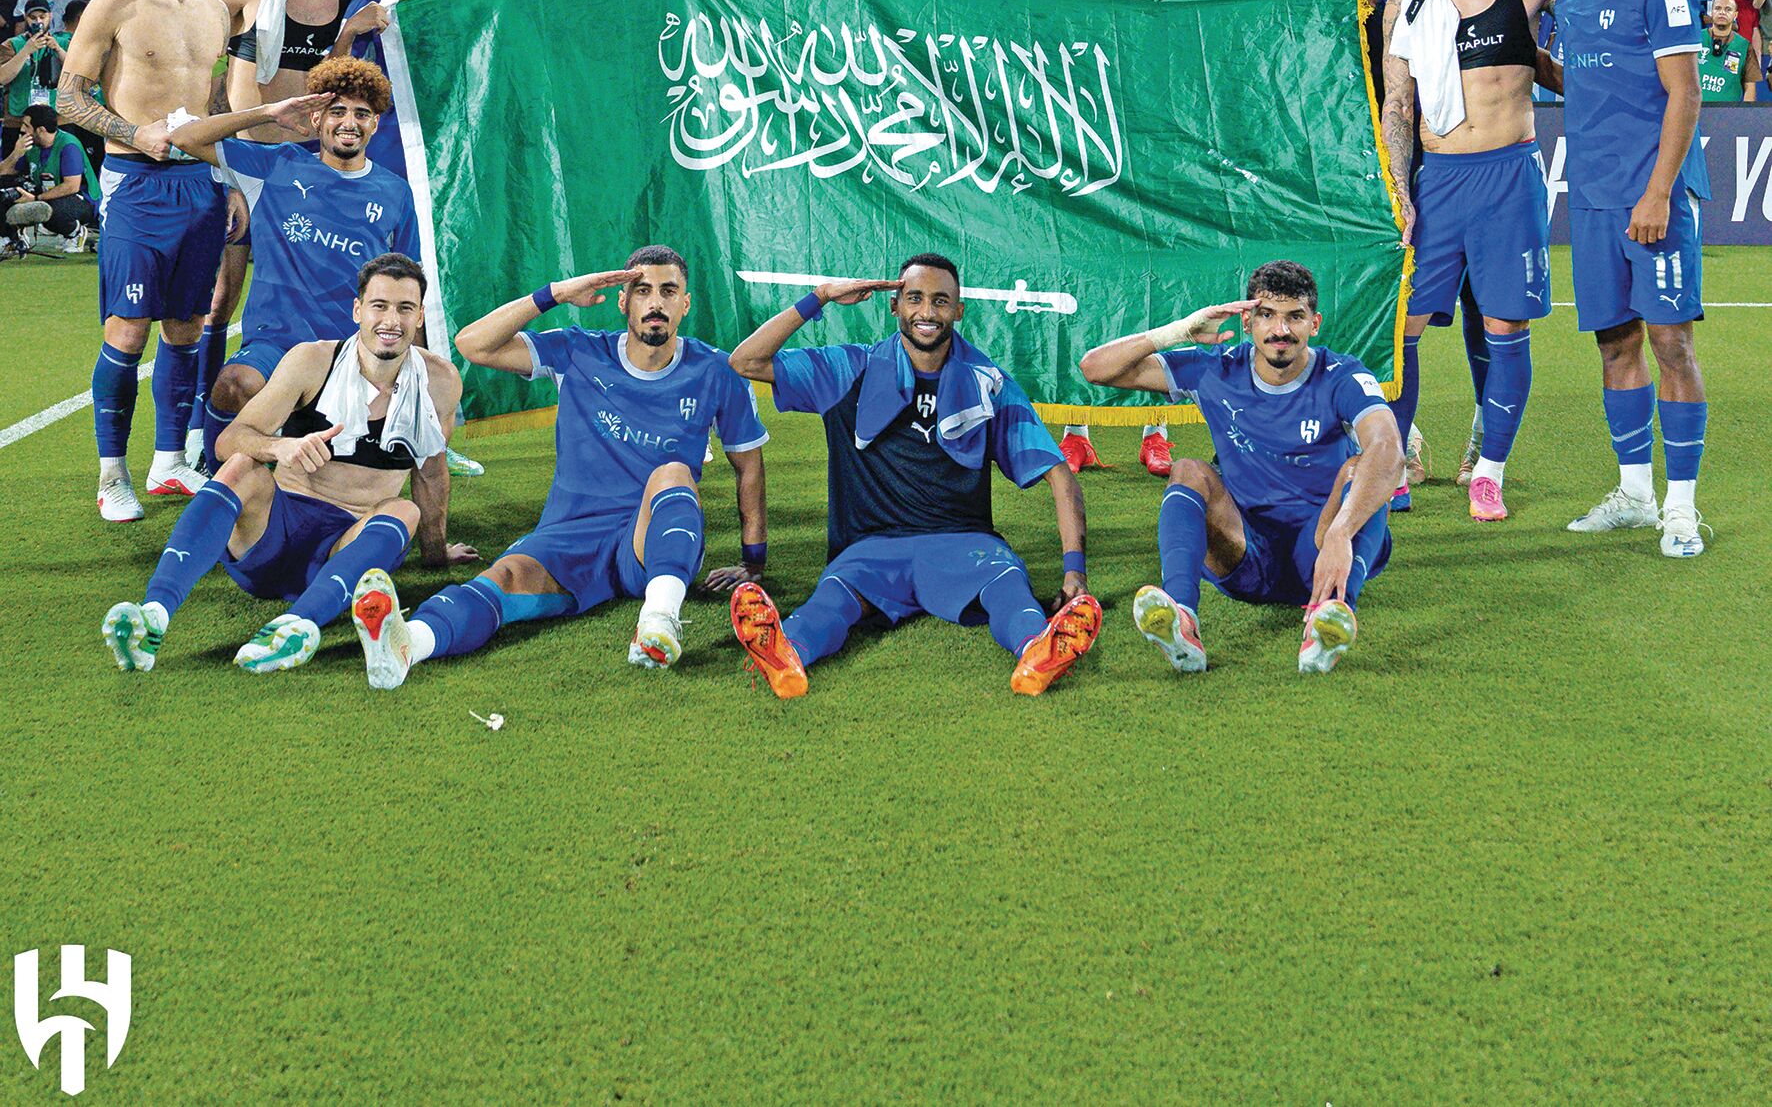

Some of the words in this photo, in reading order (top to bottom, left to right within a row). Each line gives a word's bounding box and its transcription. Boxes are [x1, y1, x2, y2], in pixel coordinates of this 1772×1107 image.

[281, 45, 323, 56] CATAPU
[1456, 34, 1504, 53] TAPULT
[1577, 52, 1614, 69] NHC
[1701, 82, 1723, 93] 1360
[1702, 74, 1726, 87] PHO
[1731, 136, 1772, 223] Y
[313, 228, 364, 256] NHC
[1652, 251, 1684, 290] 11
[623, 425, 680, 453] NHC
